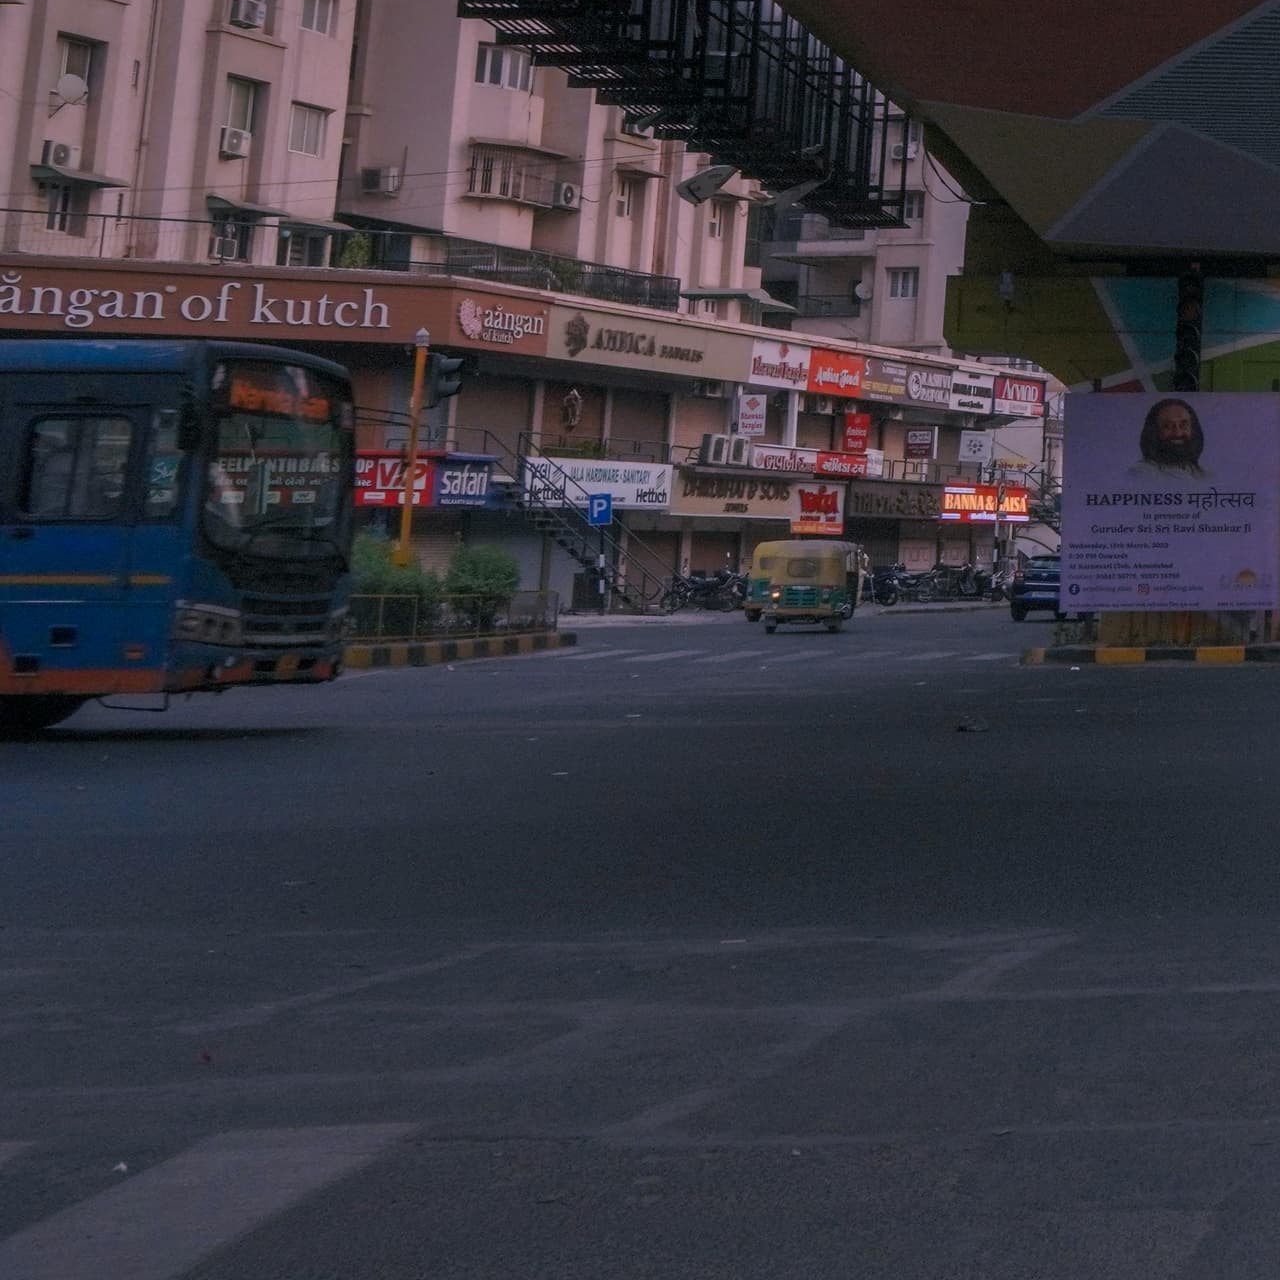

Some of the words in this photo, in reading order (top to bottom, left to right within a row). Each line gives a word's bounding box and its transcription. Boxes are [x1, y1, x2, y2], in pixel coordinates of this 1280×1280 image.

[180, 282, 241, 322] of
[250, 283, 392, 328] kutch
[439, 463, 489, 496] safari
[635, 488, 667, 504] Hettich
[944, 493, 984, 511] BANNA
[1086, 493, 1183, 506] HAPPINESS
[1187, 487, 1257, 511] महोत्सव
[592, 498, 607, 518] P
[1091, 524, 1134, 534] Gurudev
[1137, 524, 1152, 533] Sri
[1155, 524, 1170, 533] Sri
[1173, 524, 1195, 533] Ravi
[1198, 523, 1241, 533] Shankar
